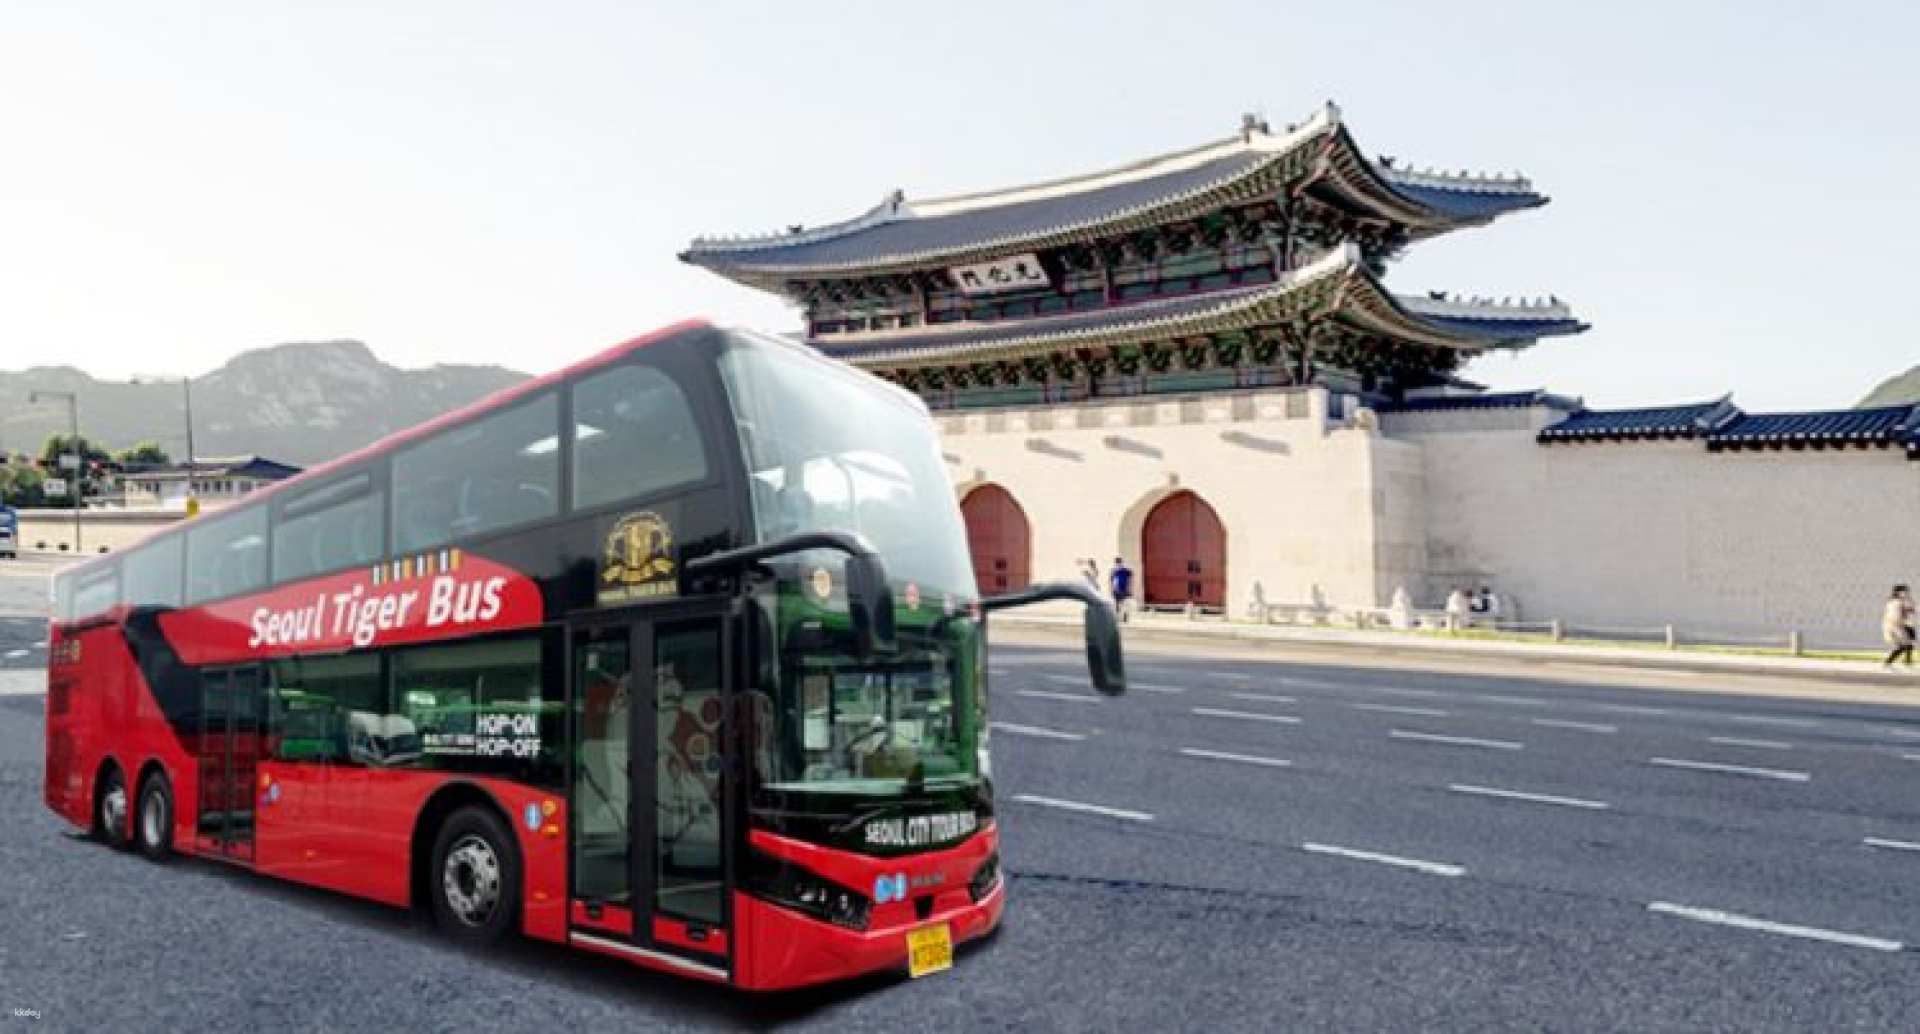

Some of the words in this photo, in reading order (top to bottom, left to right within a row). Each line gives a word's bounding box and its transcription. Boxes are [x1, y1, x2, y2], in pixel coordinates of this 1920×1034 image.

[248, 592, 326, 648] Seoul
[332, 583, 417, 647] Tiger
[426, 574, 507, 627] Bus
[477, 713, 537, 735] HOP-ON
[477, 737, 542, 757] HOP-OFF
[864, 818, 905, 845] SEOUL
